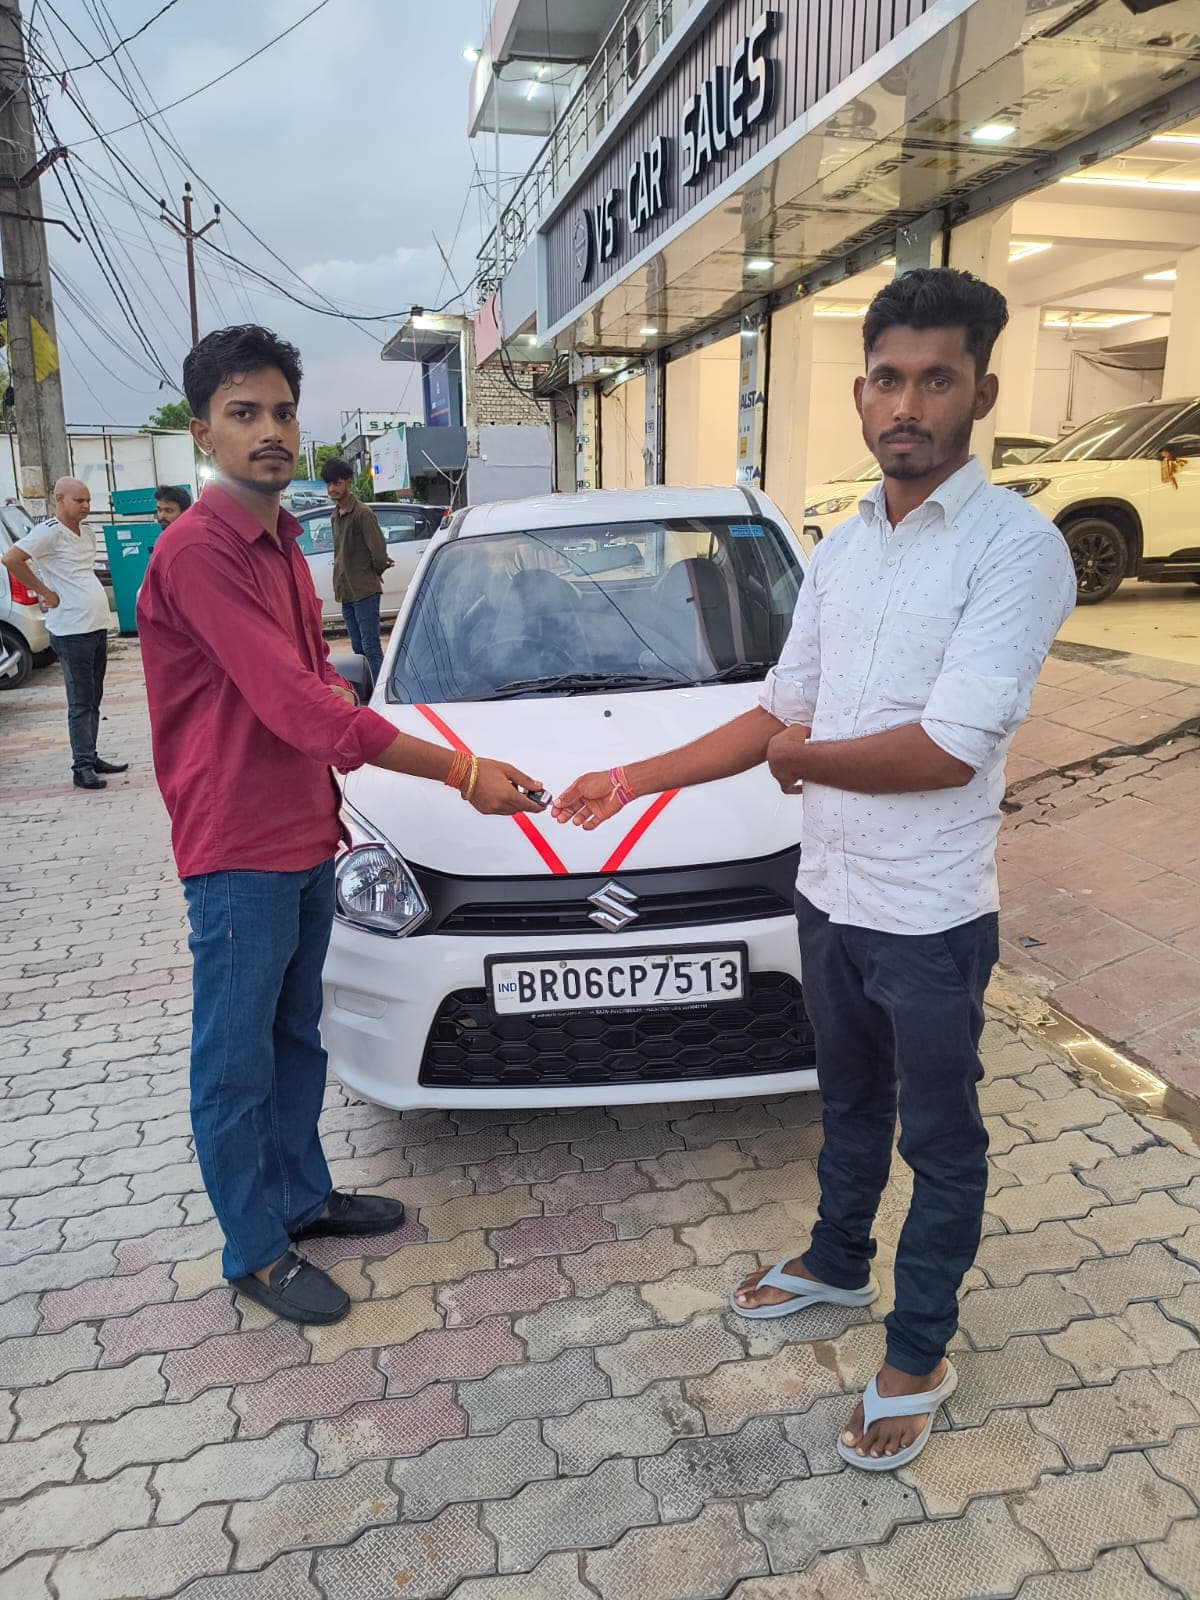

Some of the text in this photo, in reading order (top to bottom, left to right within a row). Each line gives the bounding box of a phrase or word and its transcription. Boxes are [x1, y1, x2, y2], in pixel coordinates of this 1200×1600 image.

[626, 136, 668, 232] CAR
[681, 11, 777, 186] SALES
[370, 421, 425, 429] SKOD
[498, 961, 738, 1002] IND BR06CP7513
